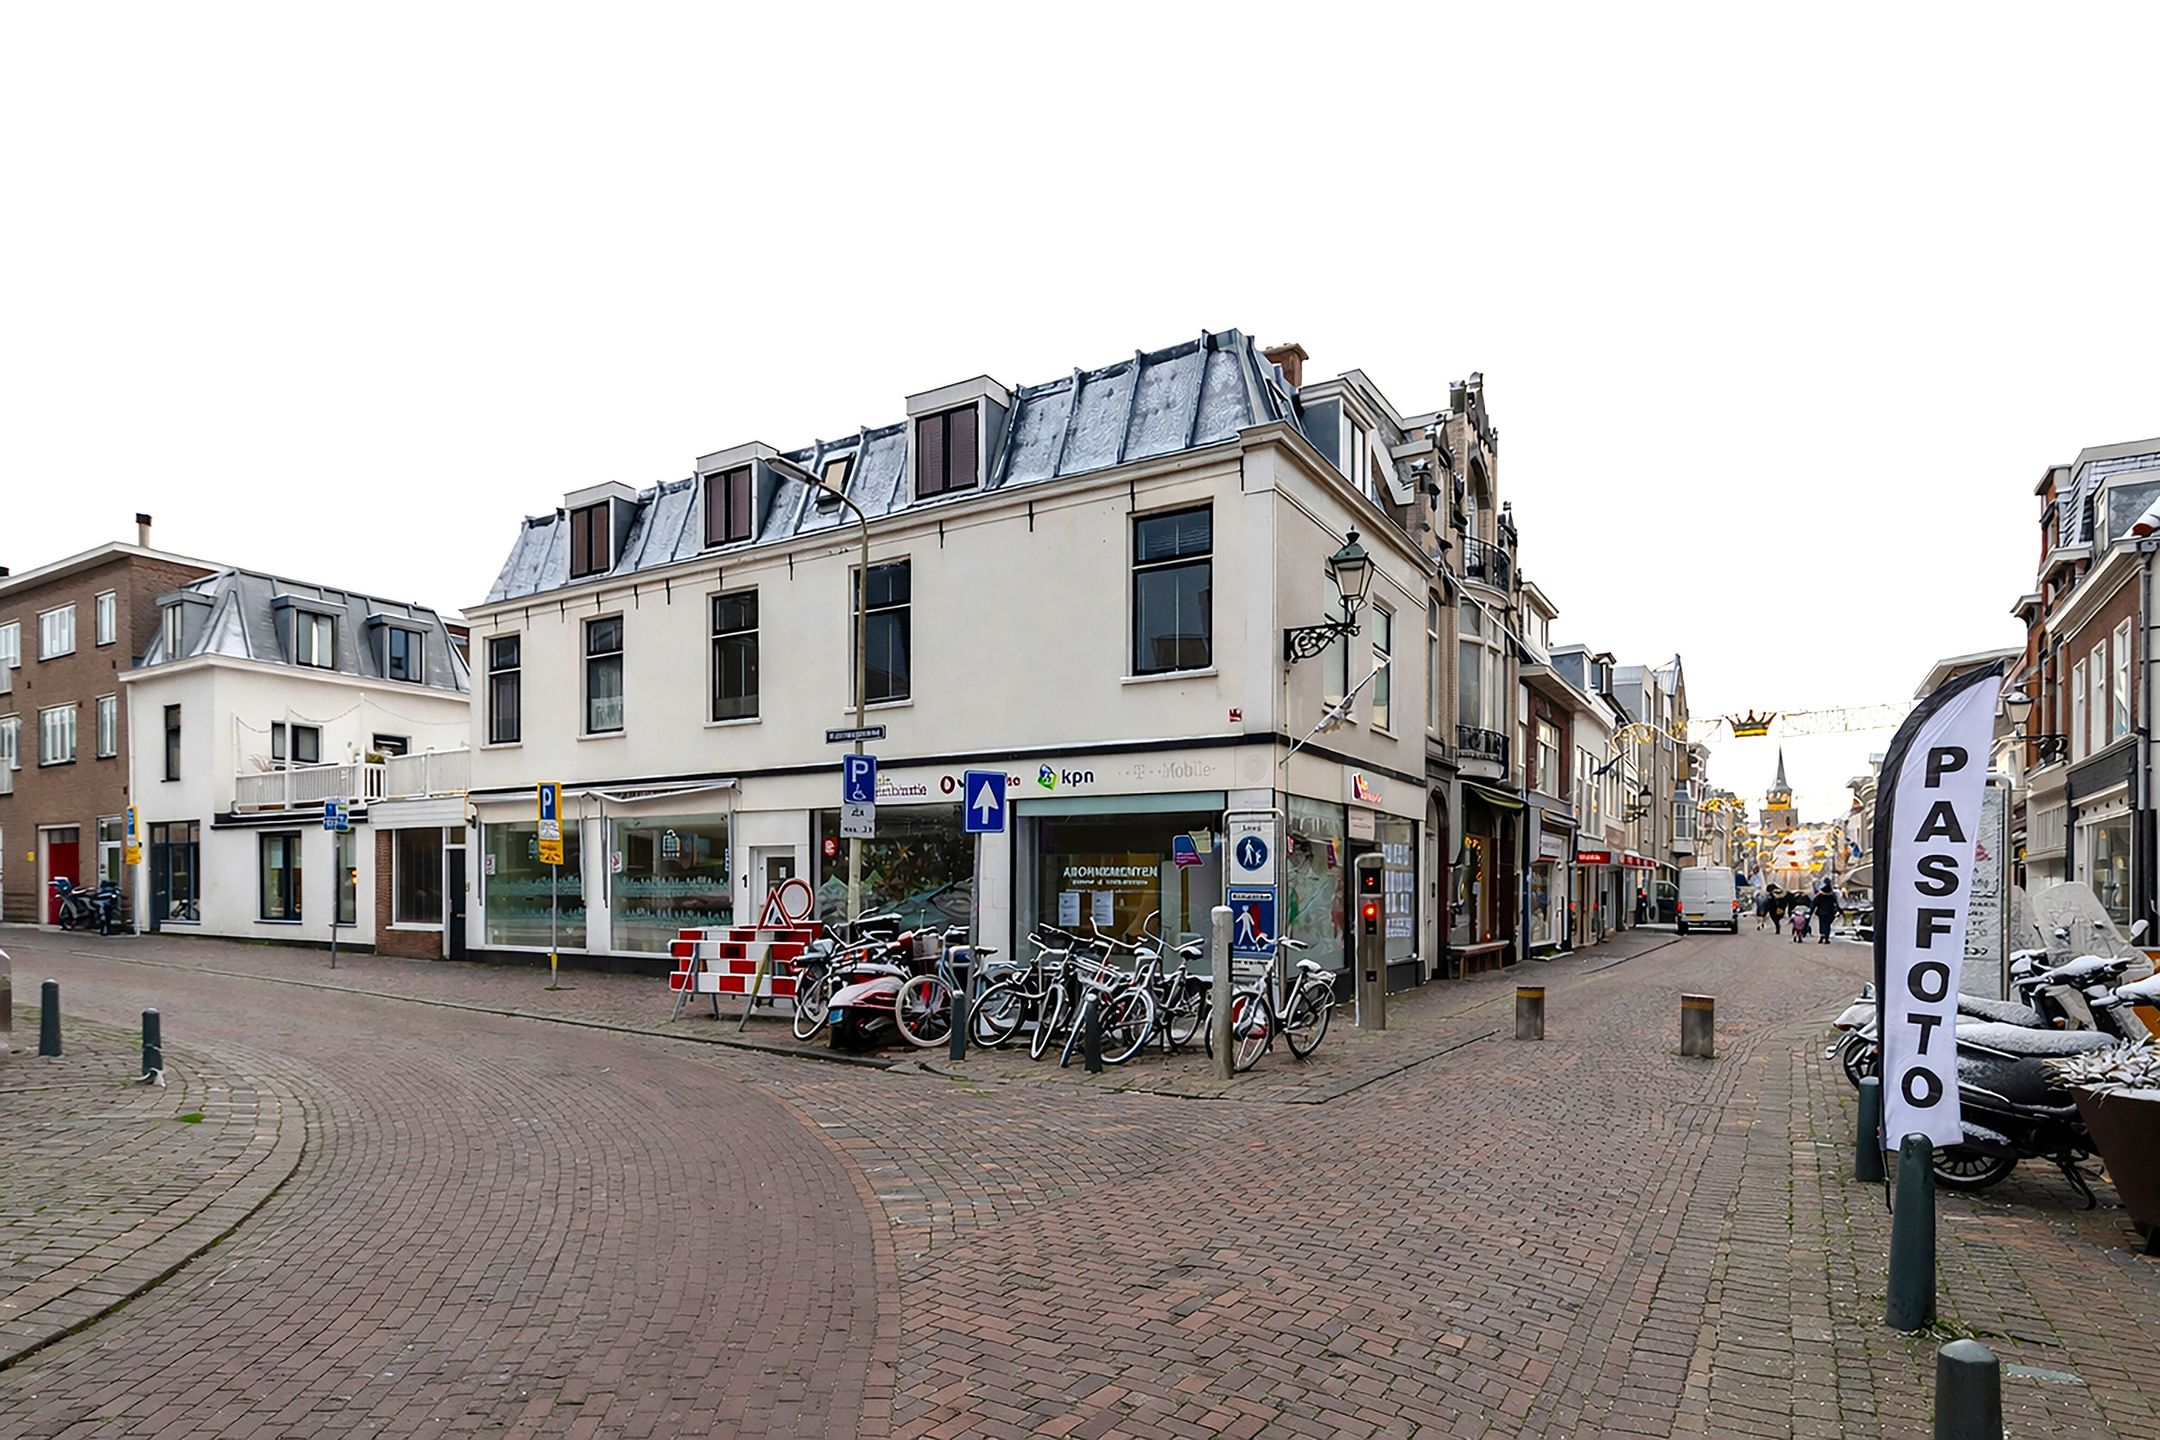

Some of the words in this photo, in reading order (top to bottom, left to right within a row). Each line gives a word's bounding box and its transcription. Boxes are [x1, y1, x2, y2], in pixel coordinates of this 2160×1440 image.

[852, 760, 869, 783] P
[1061, 769, 1095, 787] kpn
[542, 787, 552, 819] P
[741, 874, 748, 888] 1
[1901, 747, 1969, 1108] PASFOTO
